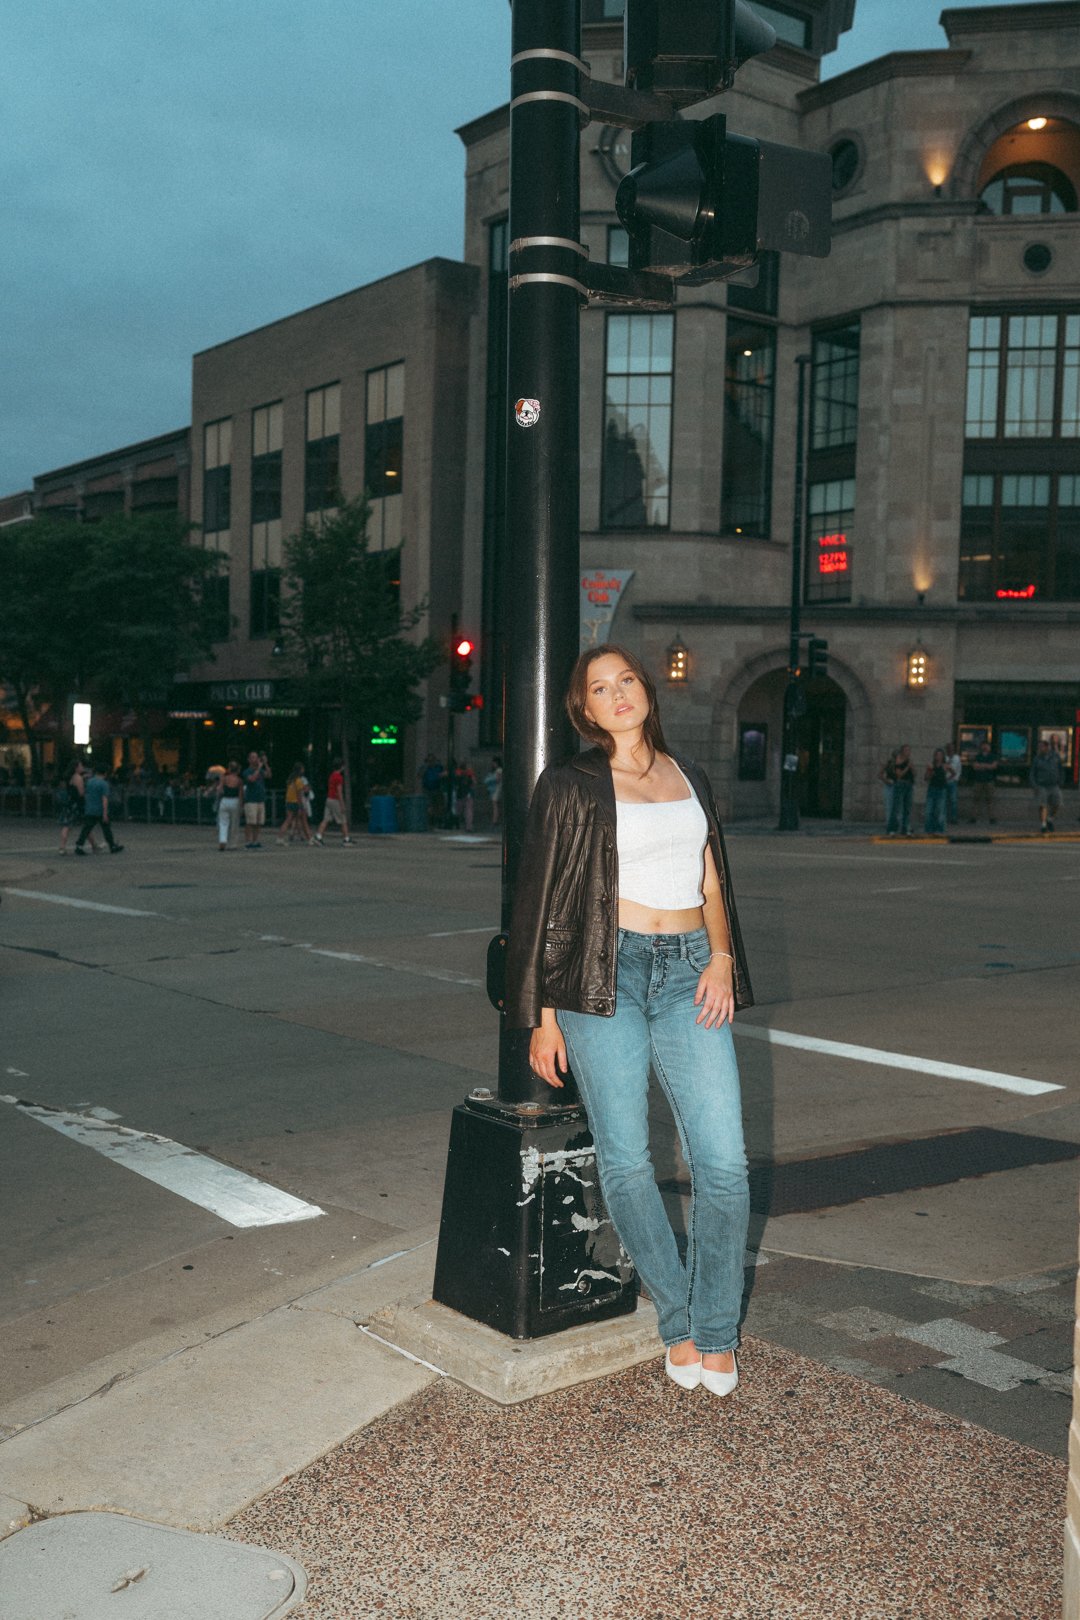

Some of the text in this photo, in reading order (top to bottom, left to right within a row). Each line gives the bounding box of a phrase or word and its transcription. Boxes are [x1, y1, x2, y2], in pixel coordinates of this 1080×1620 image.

[581, 576, 622, 592] Comedy
[587, 591, 609, 603] Club
[245, 684, 272, 699] CLUB
